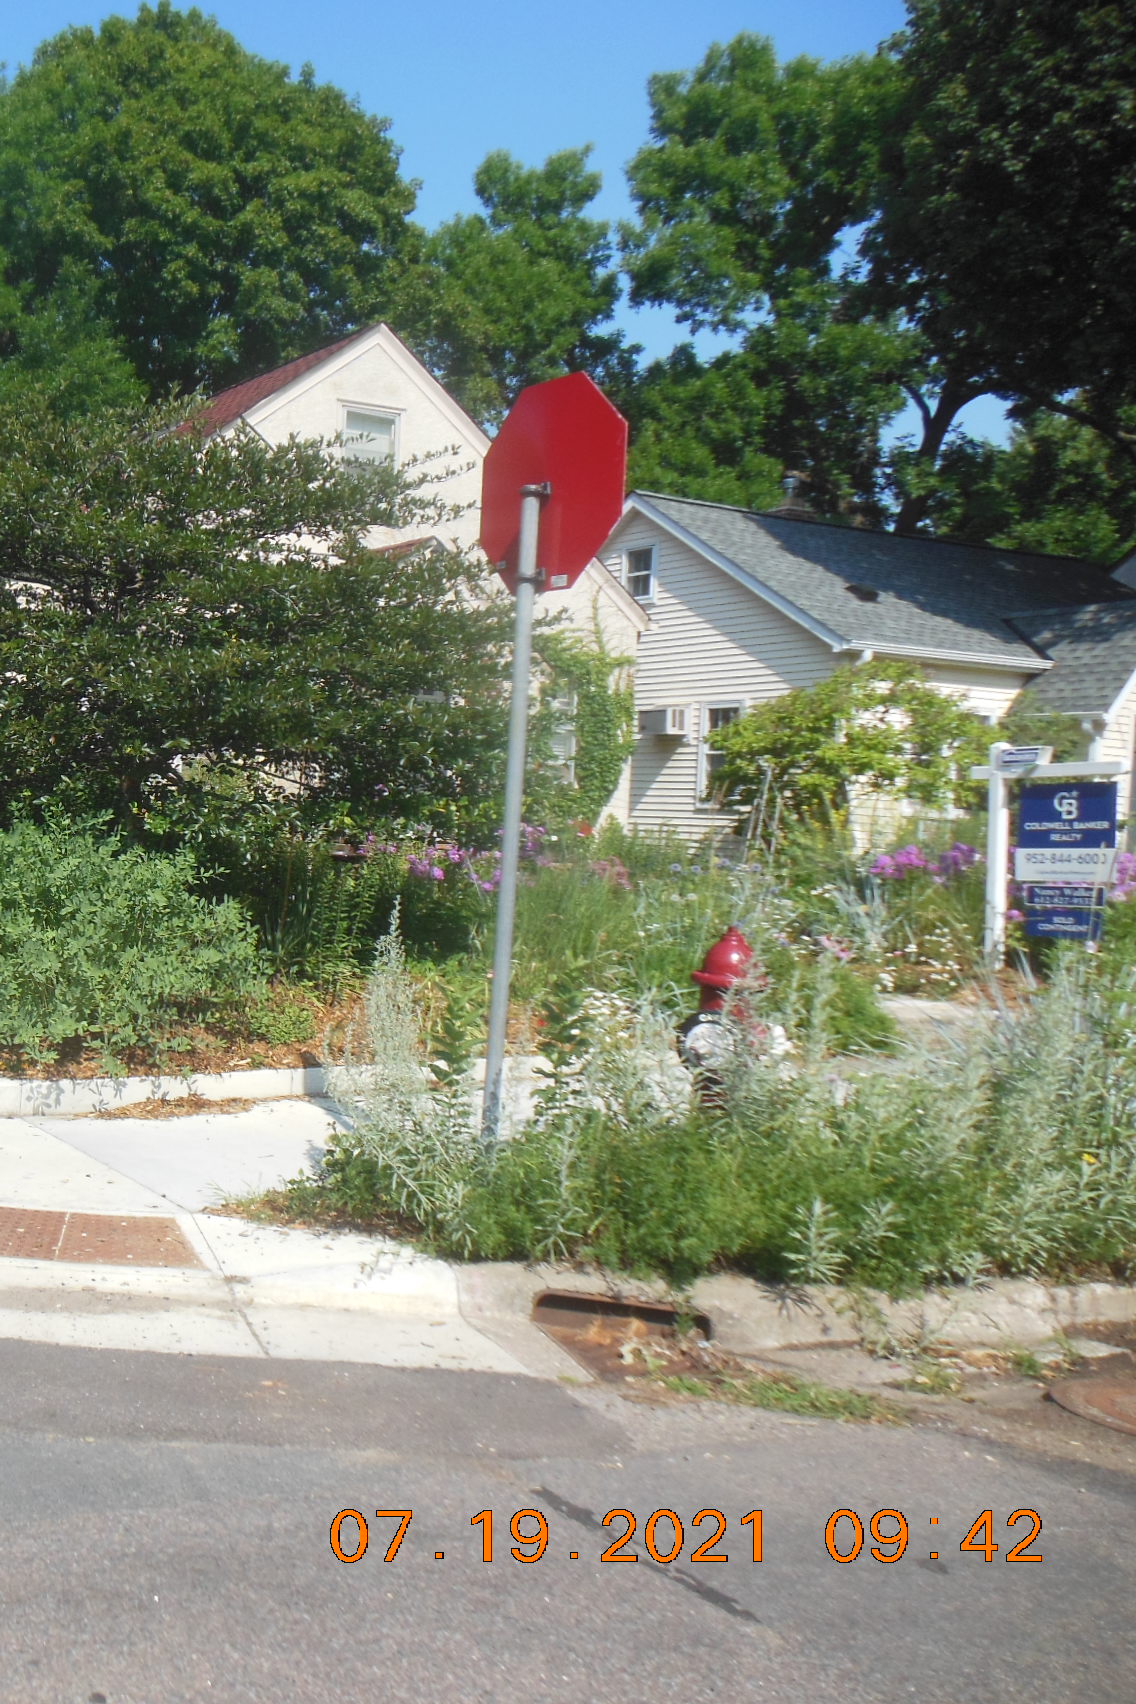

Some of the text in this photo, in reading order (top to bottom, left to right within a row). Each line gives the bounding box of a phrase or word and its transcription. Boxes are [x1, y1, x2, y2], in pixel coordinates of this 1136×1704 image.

[1024, 821, 1110, 830] COLDWELL BANKER
[1049, 833, 1082, 841] REALTY
